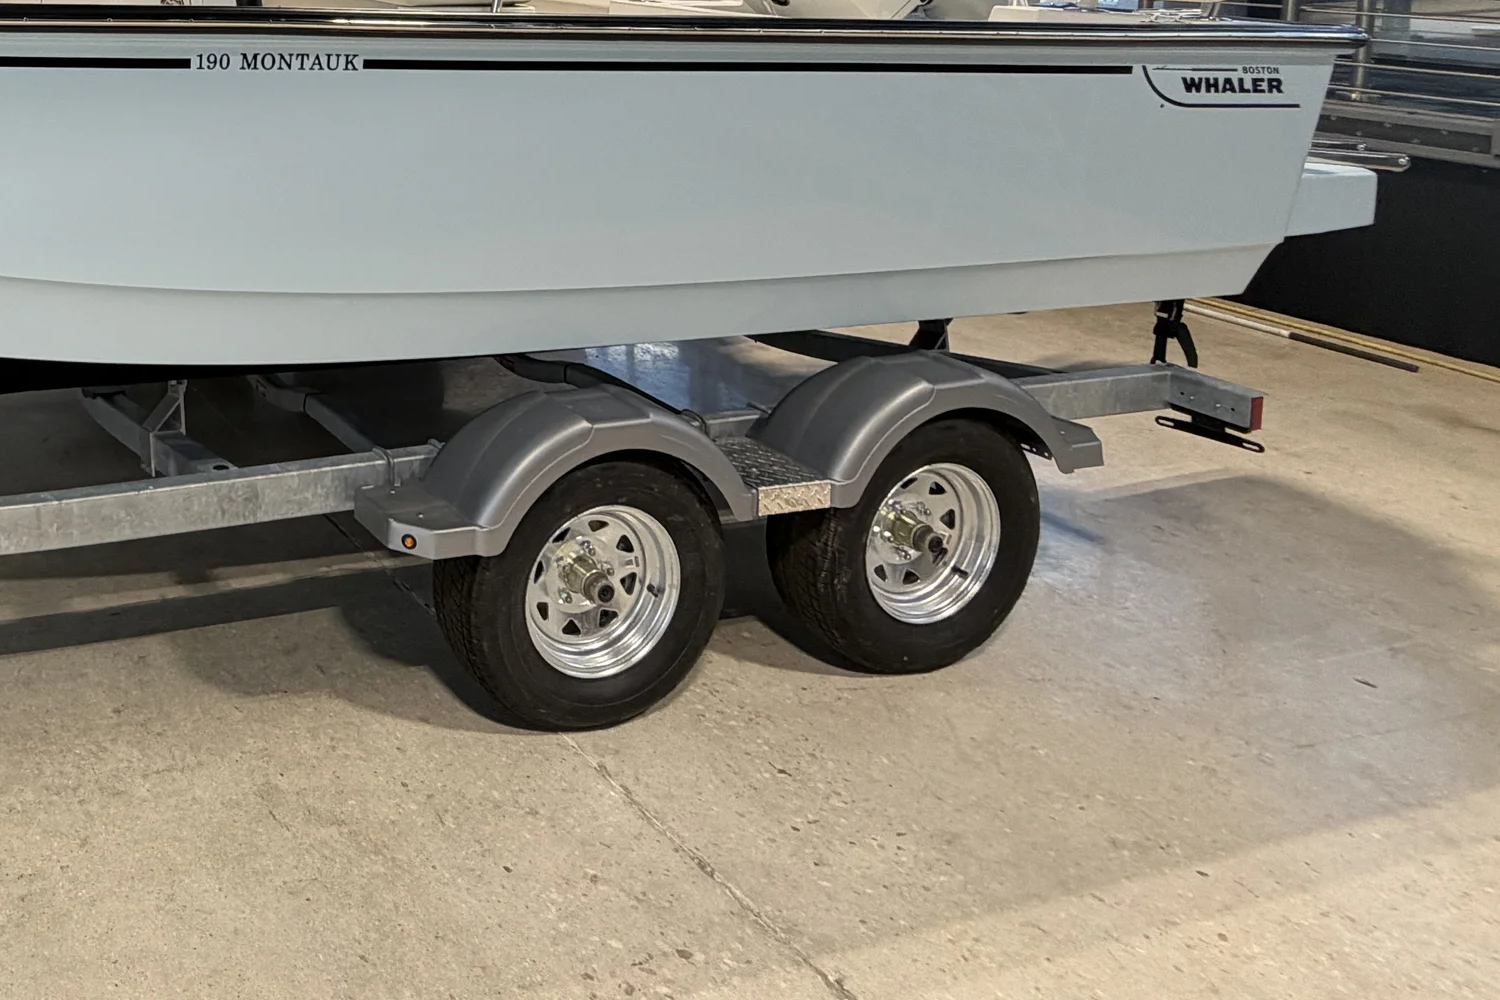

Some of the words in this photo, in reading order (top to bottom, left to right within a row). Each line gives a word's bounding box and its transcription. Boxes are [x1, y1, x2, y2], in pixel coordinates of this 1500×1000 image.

[196, 53, 231, 70] 190
[239, 53, 359, 71] MONTAUK
[1242, 66, 1280, 74] BOSTON
[1181, 77, 1284, 94] WHALER
